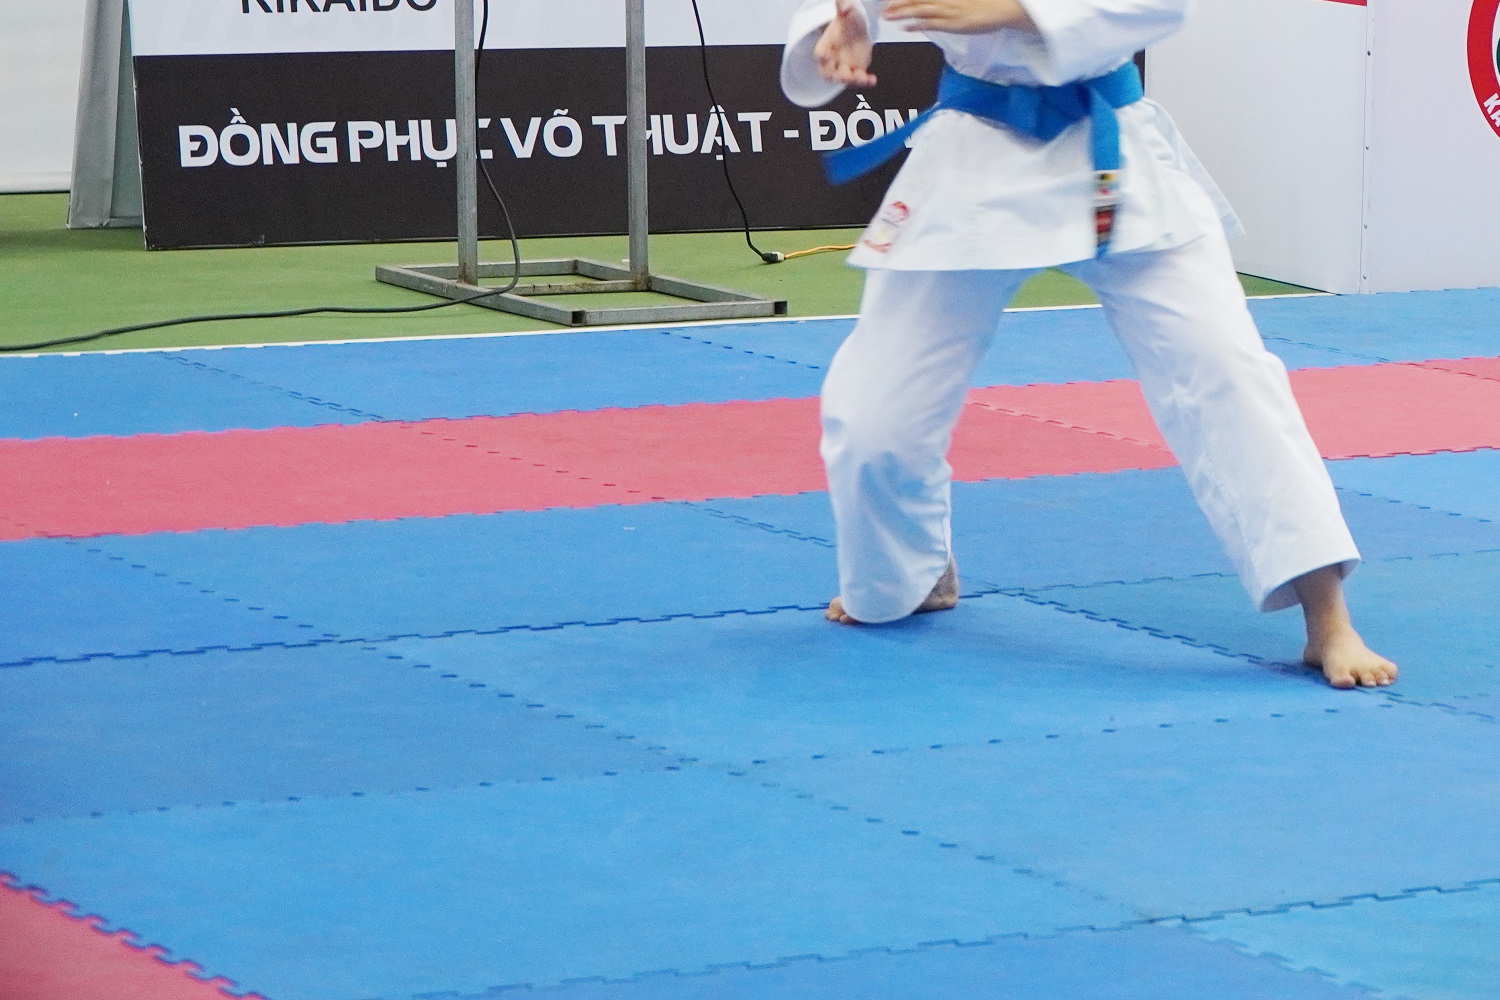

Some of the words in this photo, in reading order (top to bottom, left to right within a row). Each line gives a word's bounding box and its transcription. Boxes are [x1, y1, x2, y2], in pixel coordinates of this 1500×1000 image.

[178, 107, 339, 168] ĐỒNG
[500, 108, 583, 158] VÕ
[592, 105, 773, 161] THUẬT
[809, 94, 920, 151] ĐỒN
